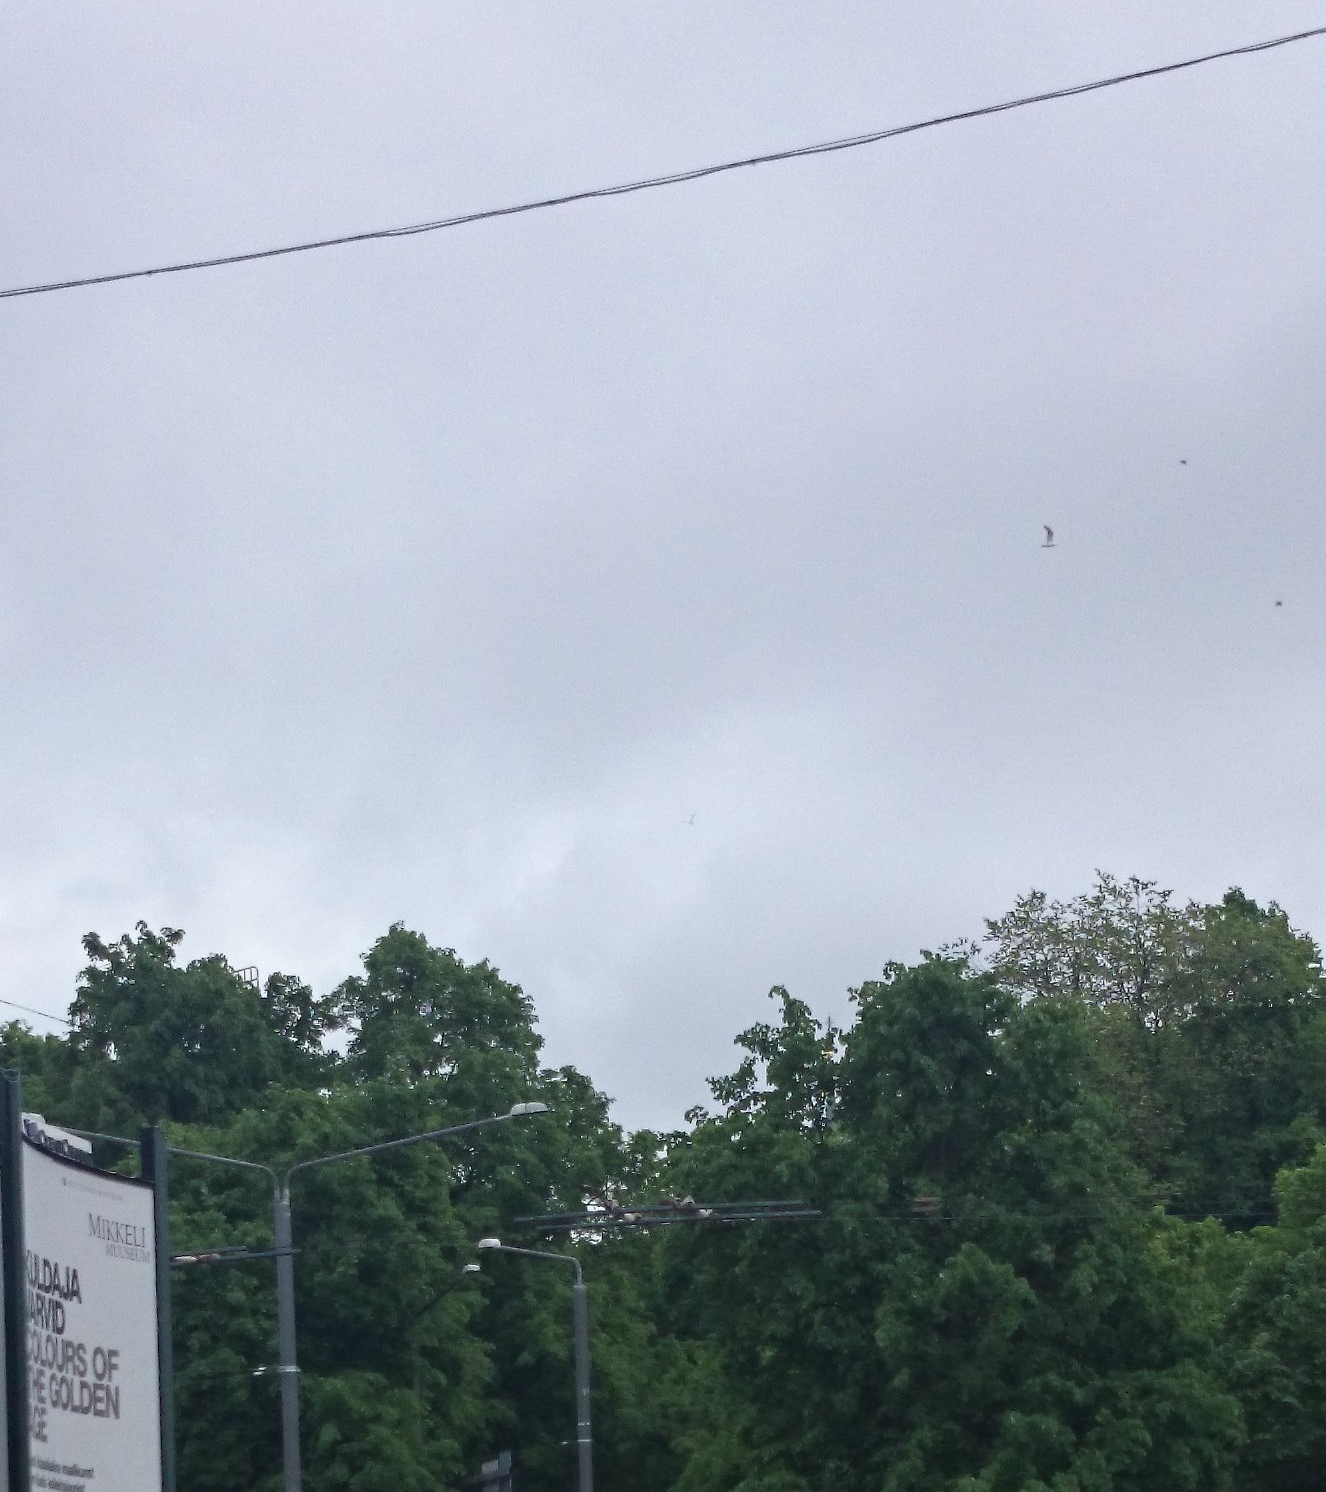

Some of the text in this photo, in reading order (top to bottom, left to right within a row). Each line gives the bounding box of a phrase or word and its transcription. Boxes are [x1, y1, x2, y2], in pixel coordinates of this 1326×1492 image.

[88, 1213, 146, 1248] MIKKELI
[28, 1289, 65, 1335] ARVID
[93, 1346, 120, 1383] OF
[50, 1373, 121, 1420] GOLDEN
